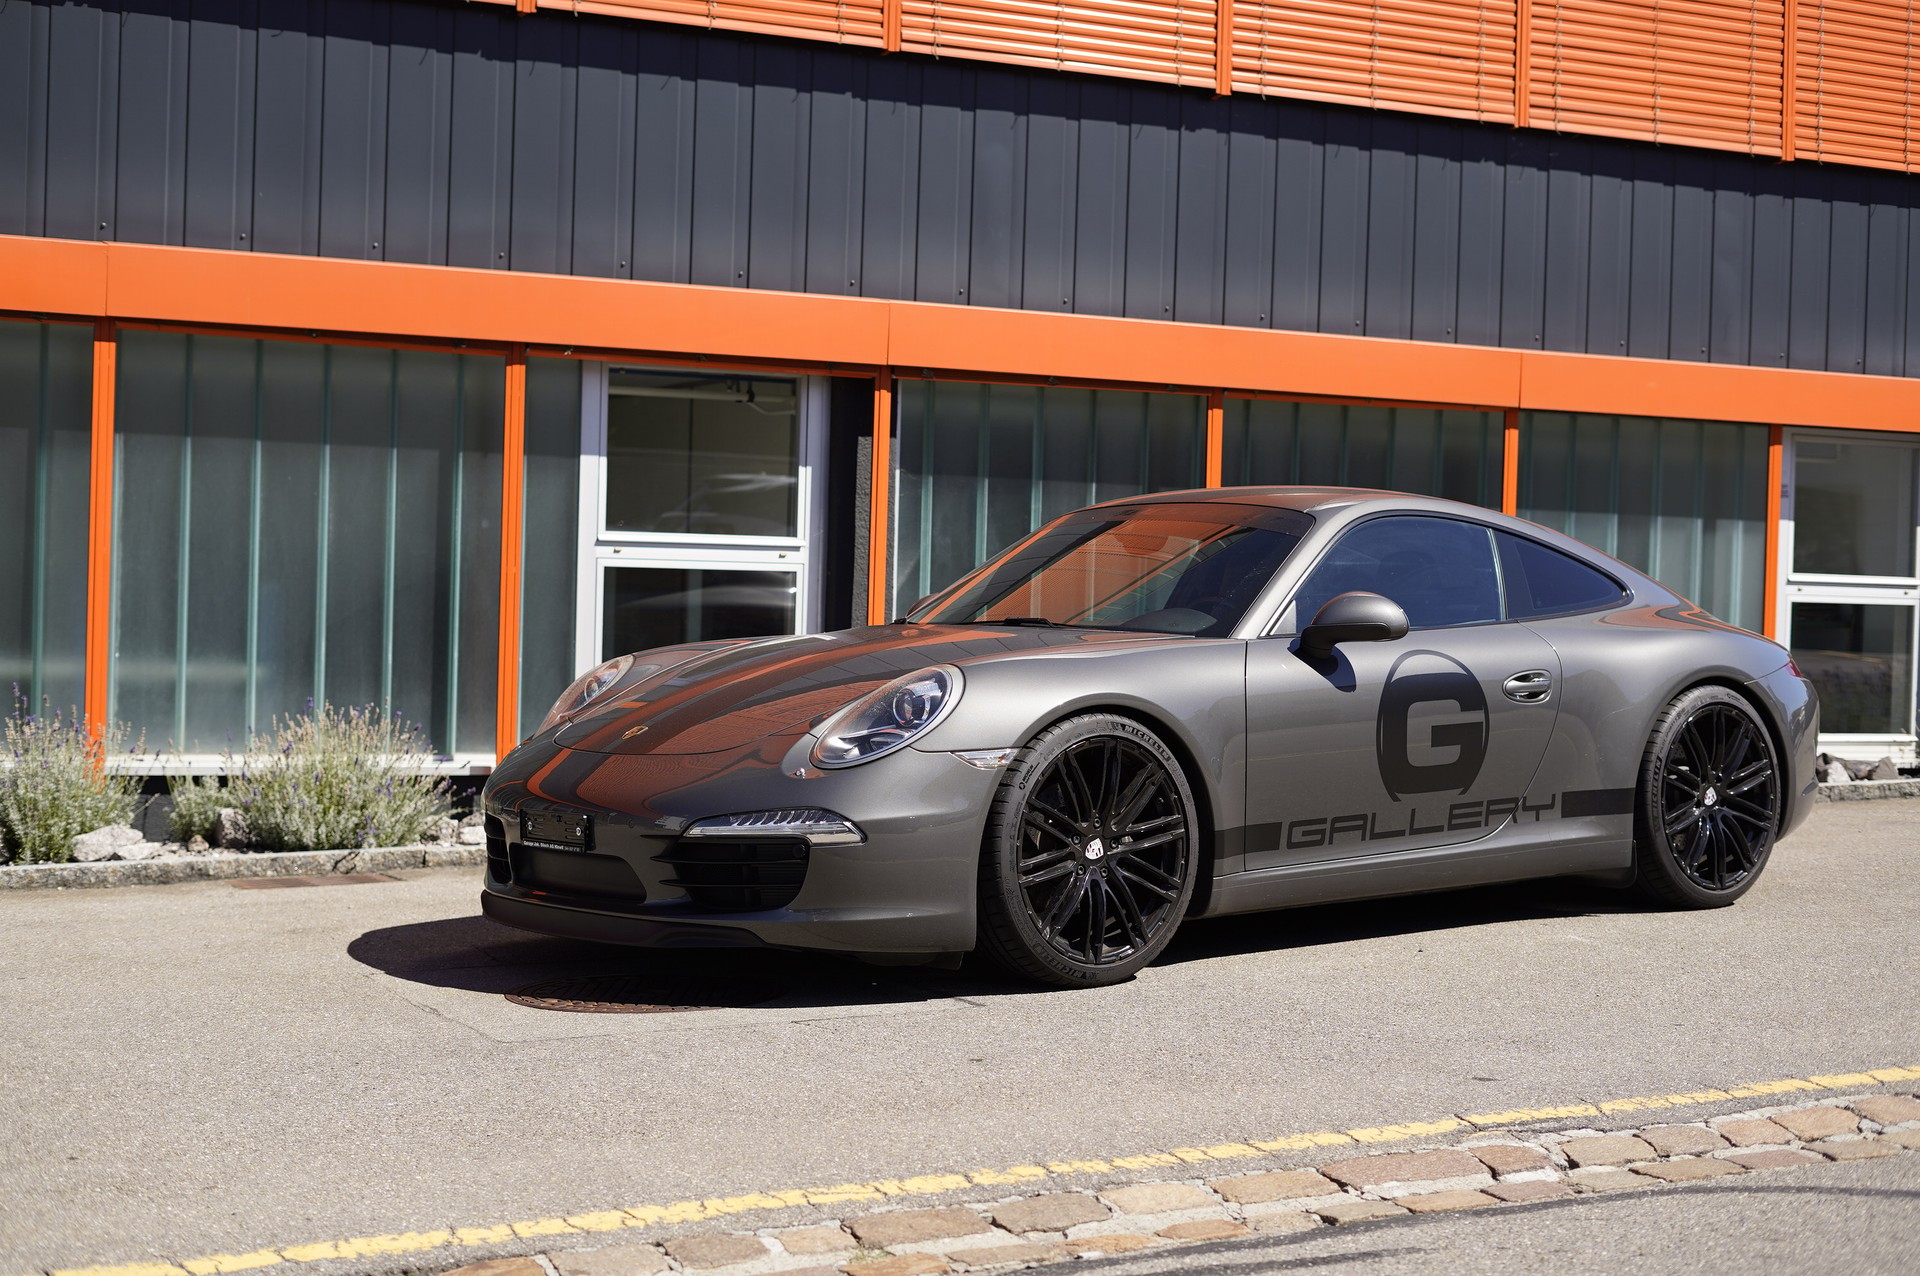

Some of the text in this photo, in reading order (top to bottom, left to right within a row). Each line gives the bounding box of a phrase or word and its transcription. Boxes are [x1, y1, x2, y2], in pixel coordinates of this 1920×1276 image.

[1124, 725, 1170, 760] MICHELIN
[1380, 672, 1484, 795] G
[1286, 793, 1556, 850] GALLERY
[1034, 943, 1084, 979] MICHELIN
